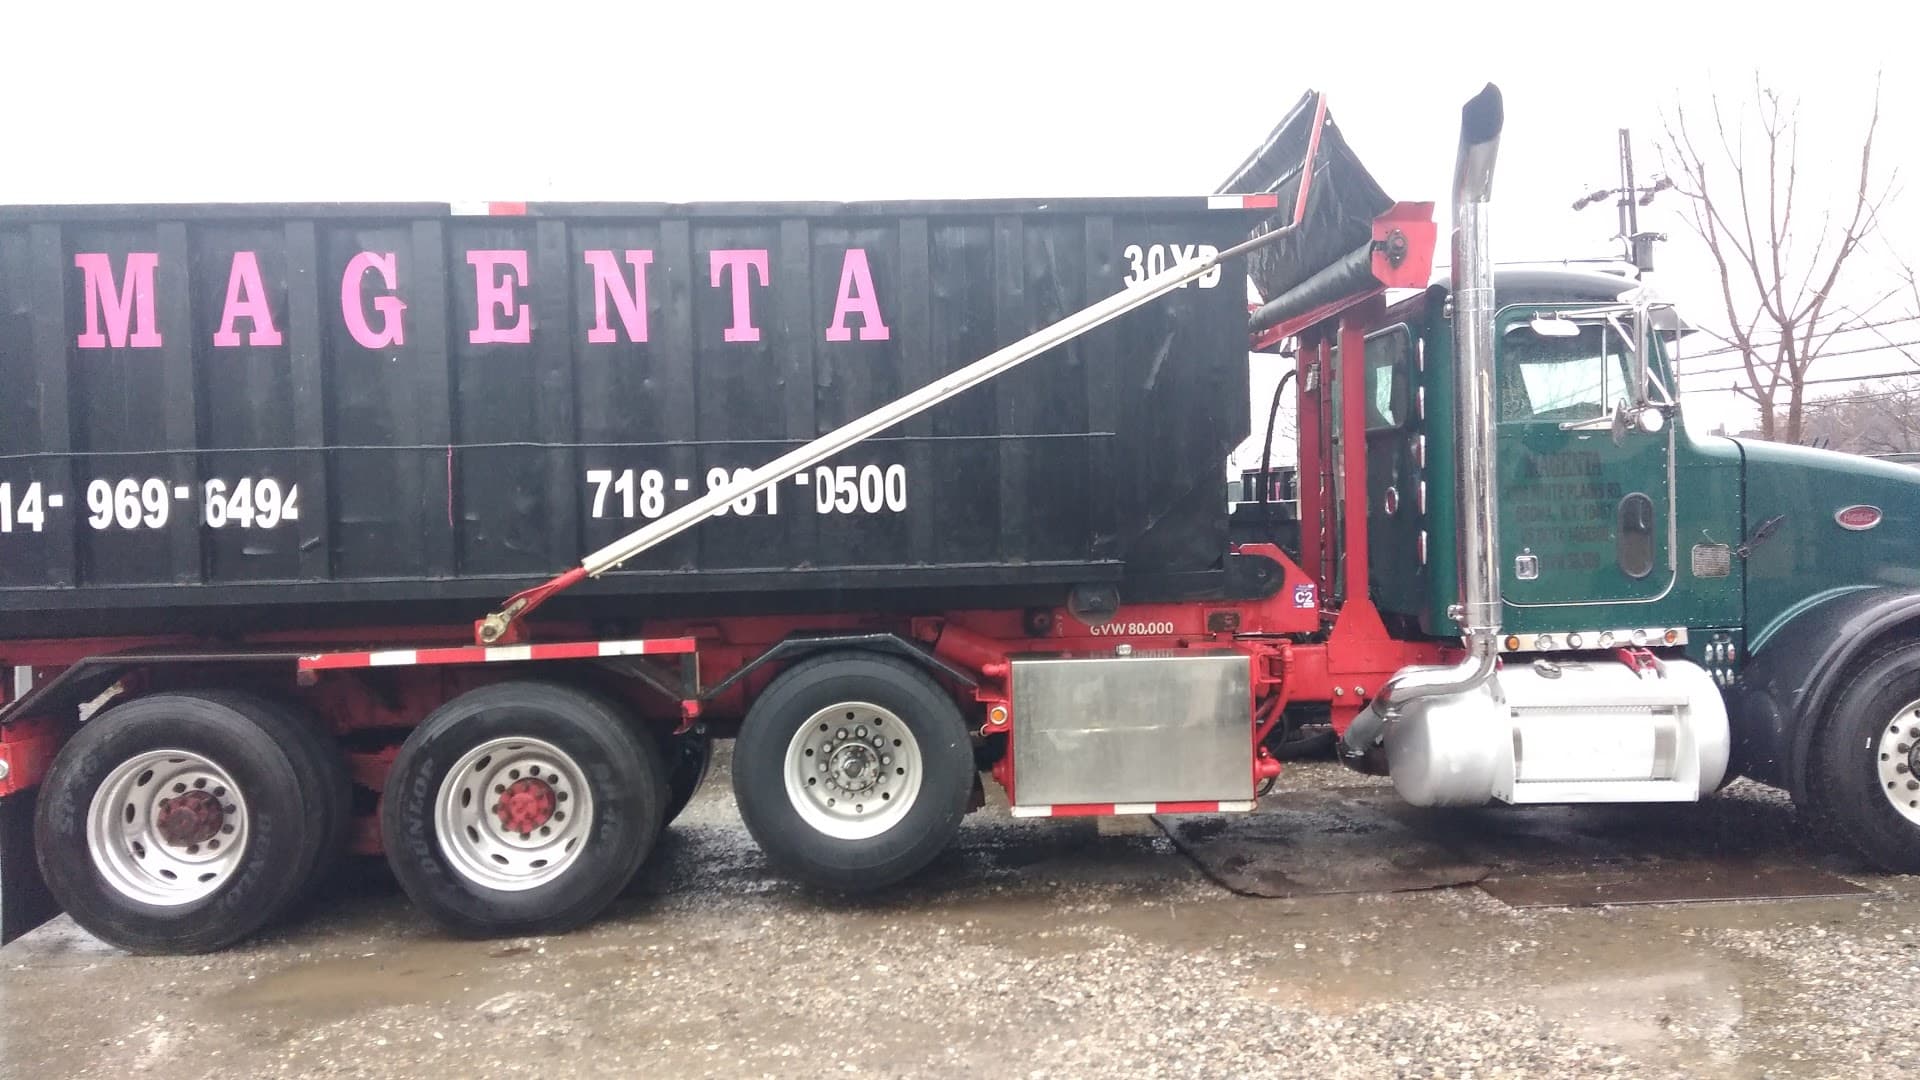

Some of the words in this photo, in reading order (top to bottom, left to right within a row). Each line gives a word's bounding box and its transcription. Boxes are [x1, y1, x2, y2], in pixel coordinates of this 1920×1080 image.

[74, 248, 890, 350] MAGENTA
[1295, 591, 1313, 603] C2
[1090, 623, 1126, 636] GVW
[1128, 622, 1174, 636] 80,000
